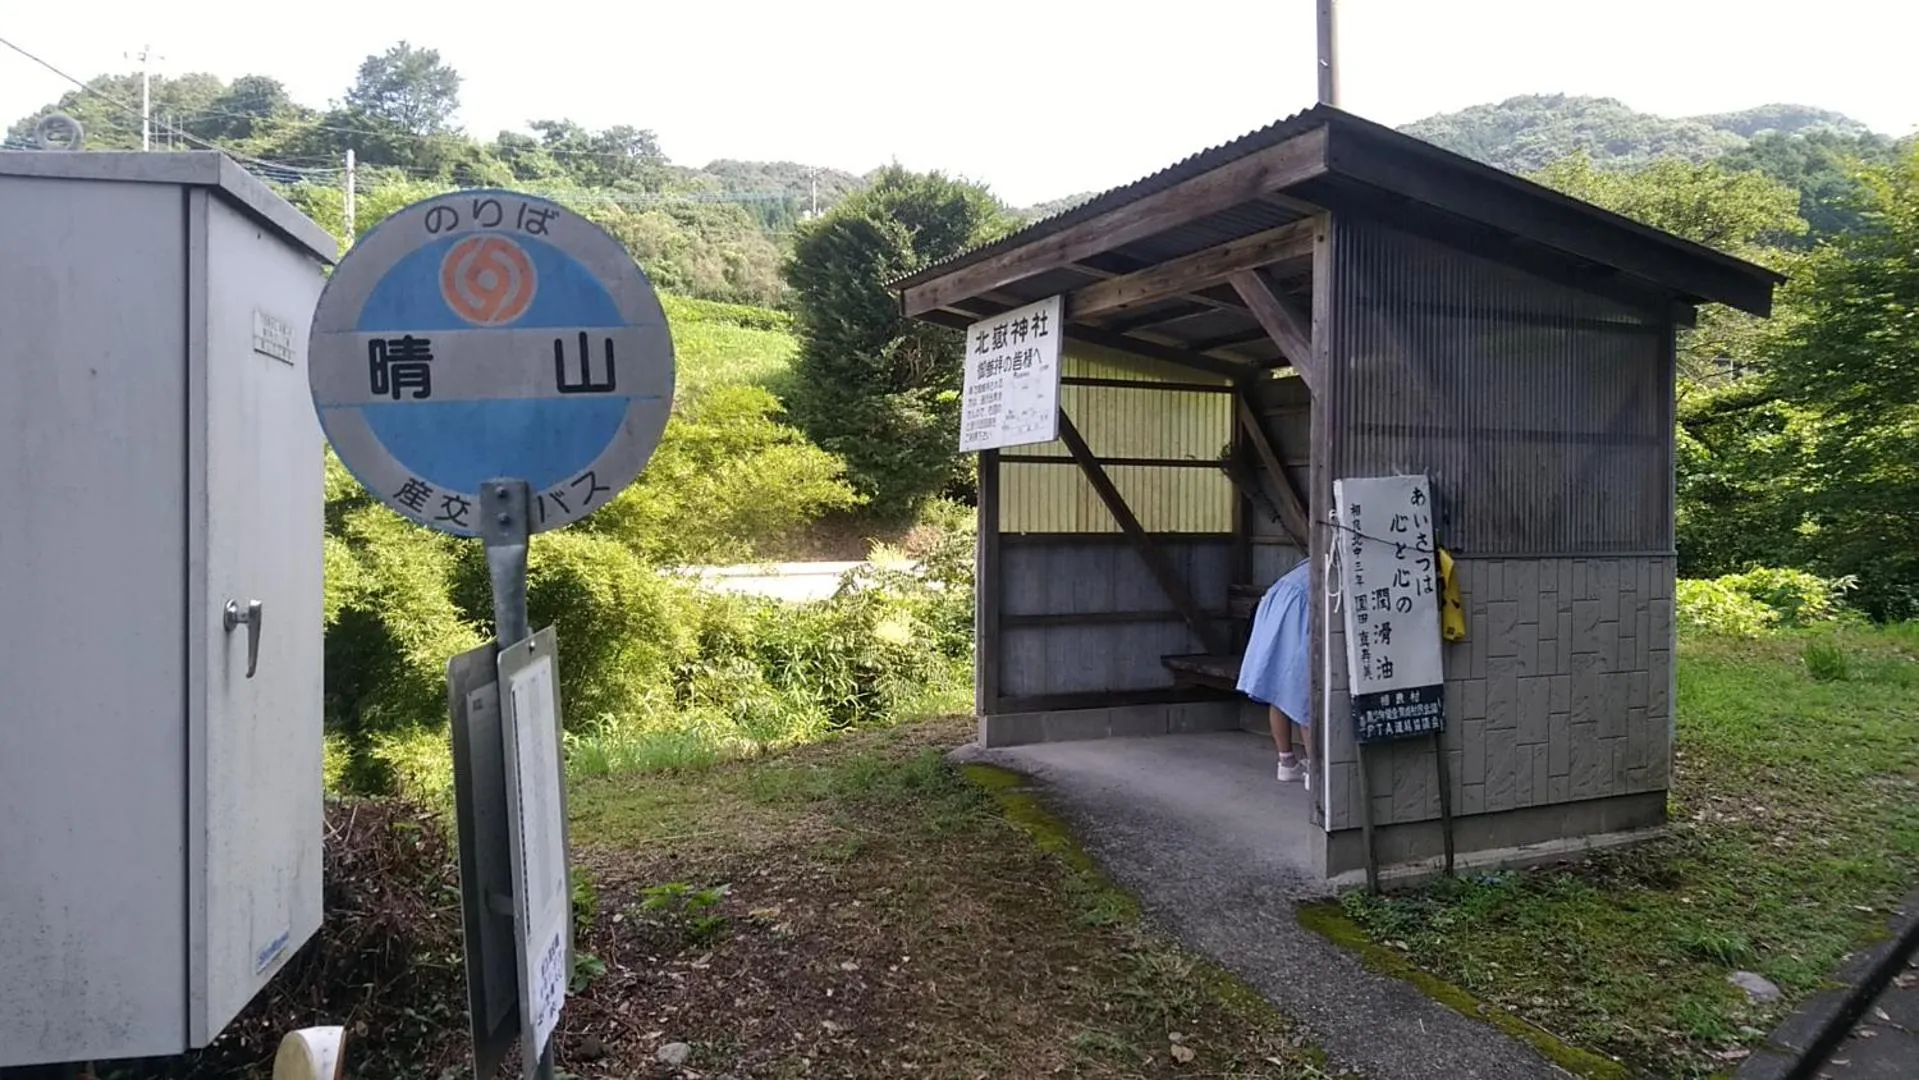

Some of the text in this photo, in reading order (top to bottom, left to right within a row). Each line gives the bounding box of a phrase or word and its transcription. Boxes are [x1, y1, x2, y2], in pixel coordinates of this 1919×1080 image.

[424, 199, 560, 236] のりば
[368, 331, 617, 400] 晴山
[975, 310, 1049, 355] 北嶽神社
[392, 470, 611, 528] 産交バス
[1390, 513, 1413, 614] 心と心の
[1411, 487, 1434, 596] あいさつは
[1371, 587, 1394, 680] 潤滑油
